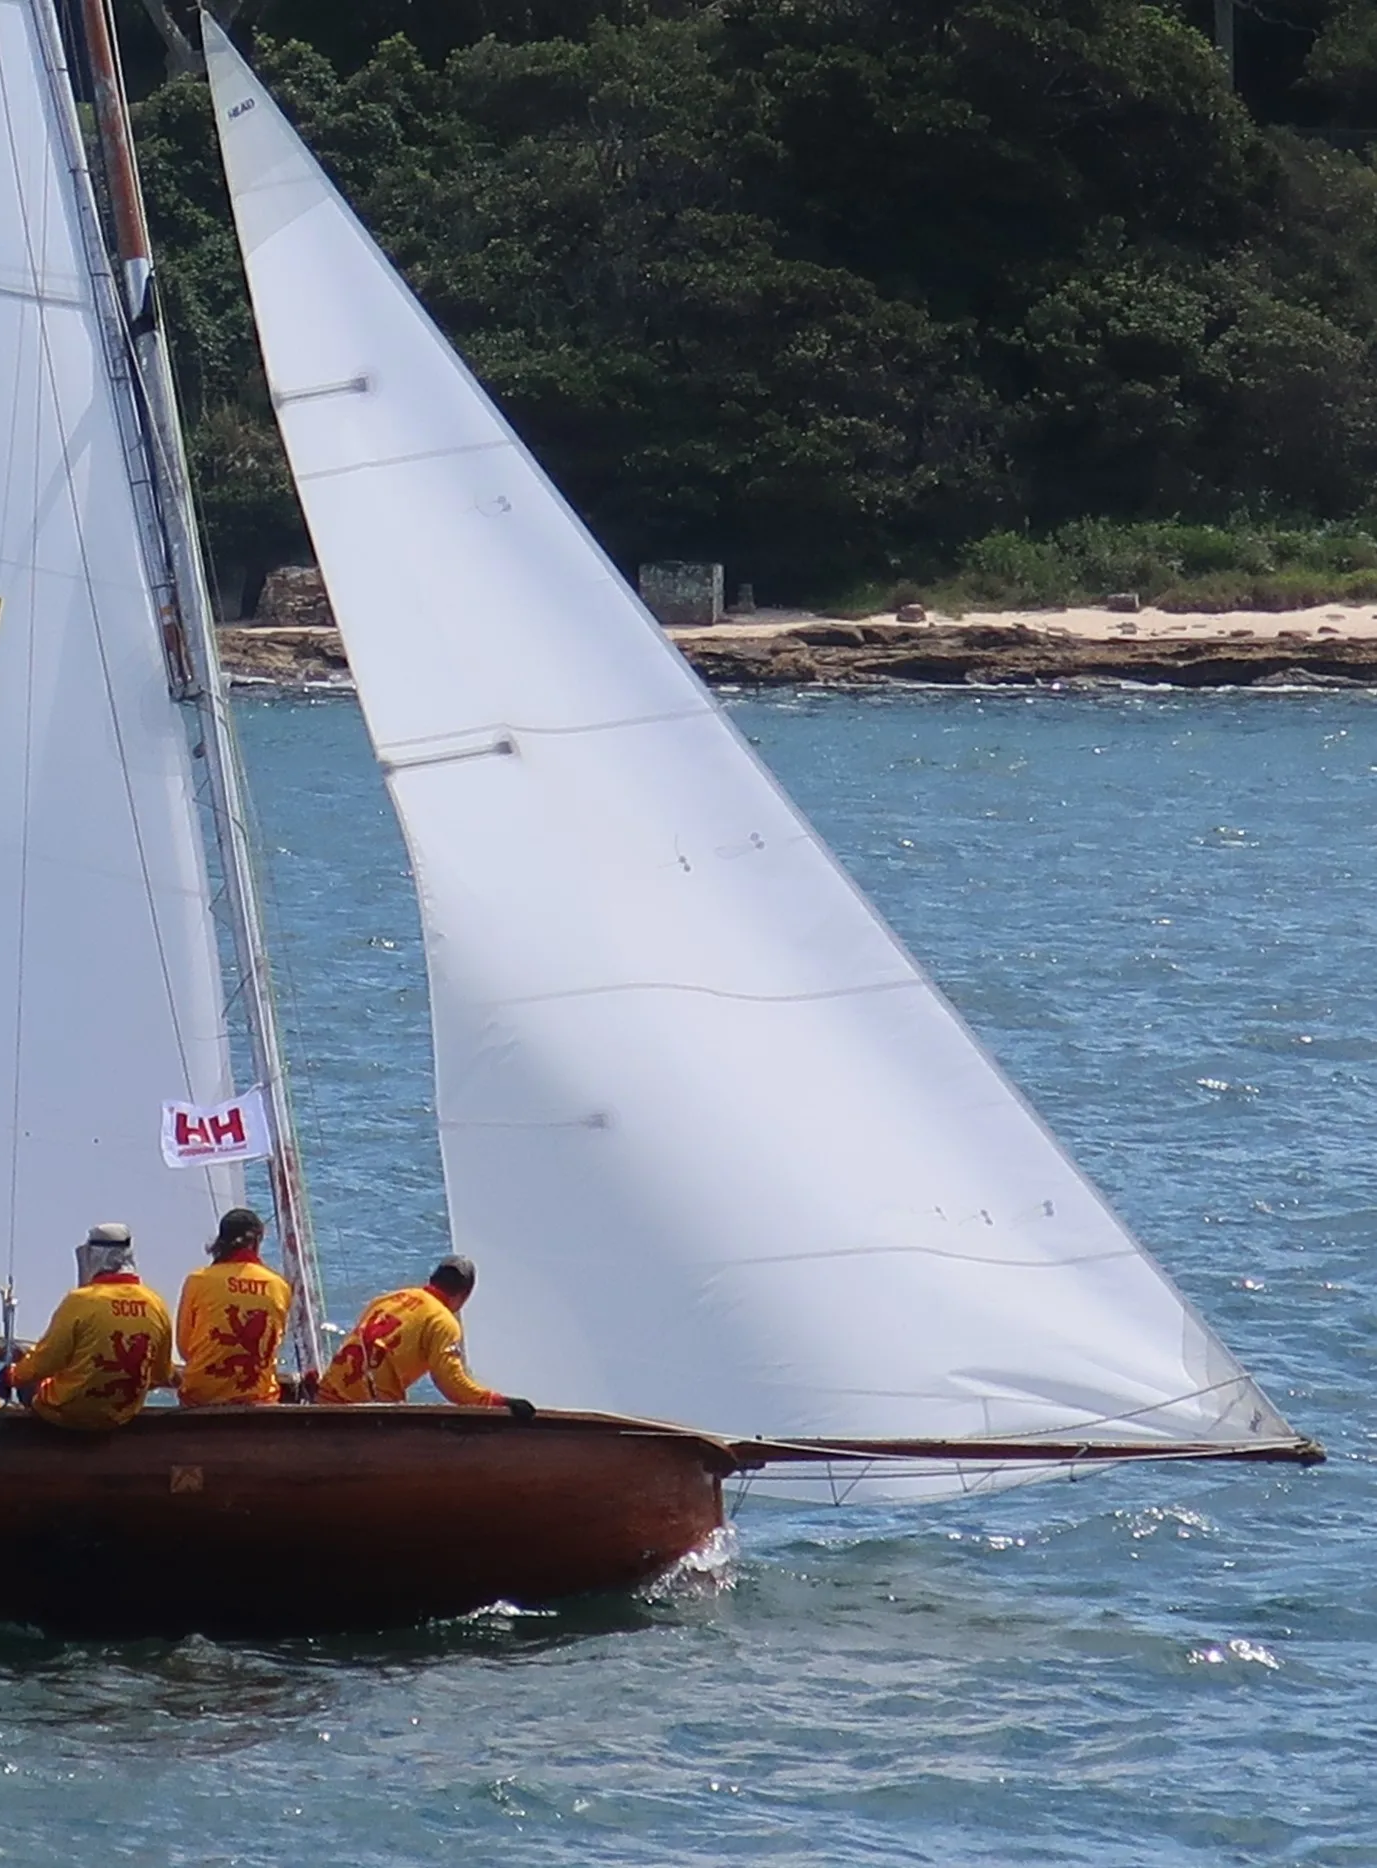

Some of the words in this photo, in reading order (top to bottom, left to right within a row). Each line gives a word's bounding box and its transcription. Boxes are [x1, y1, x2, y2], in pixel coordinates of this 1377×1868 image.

[176, 1107, 245, 1145] HH
[228, 1277, 269, 1297] SCOT
[111, 1299, 147, 1317] SCOT
